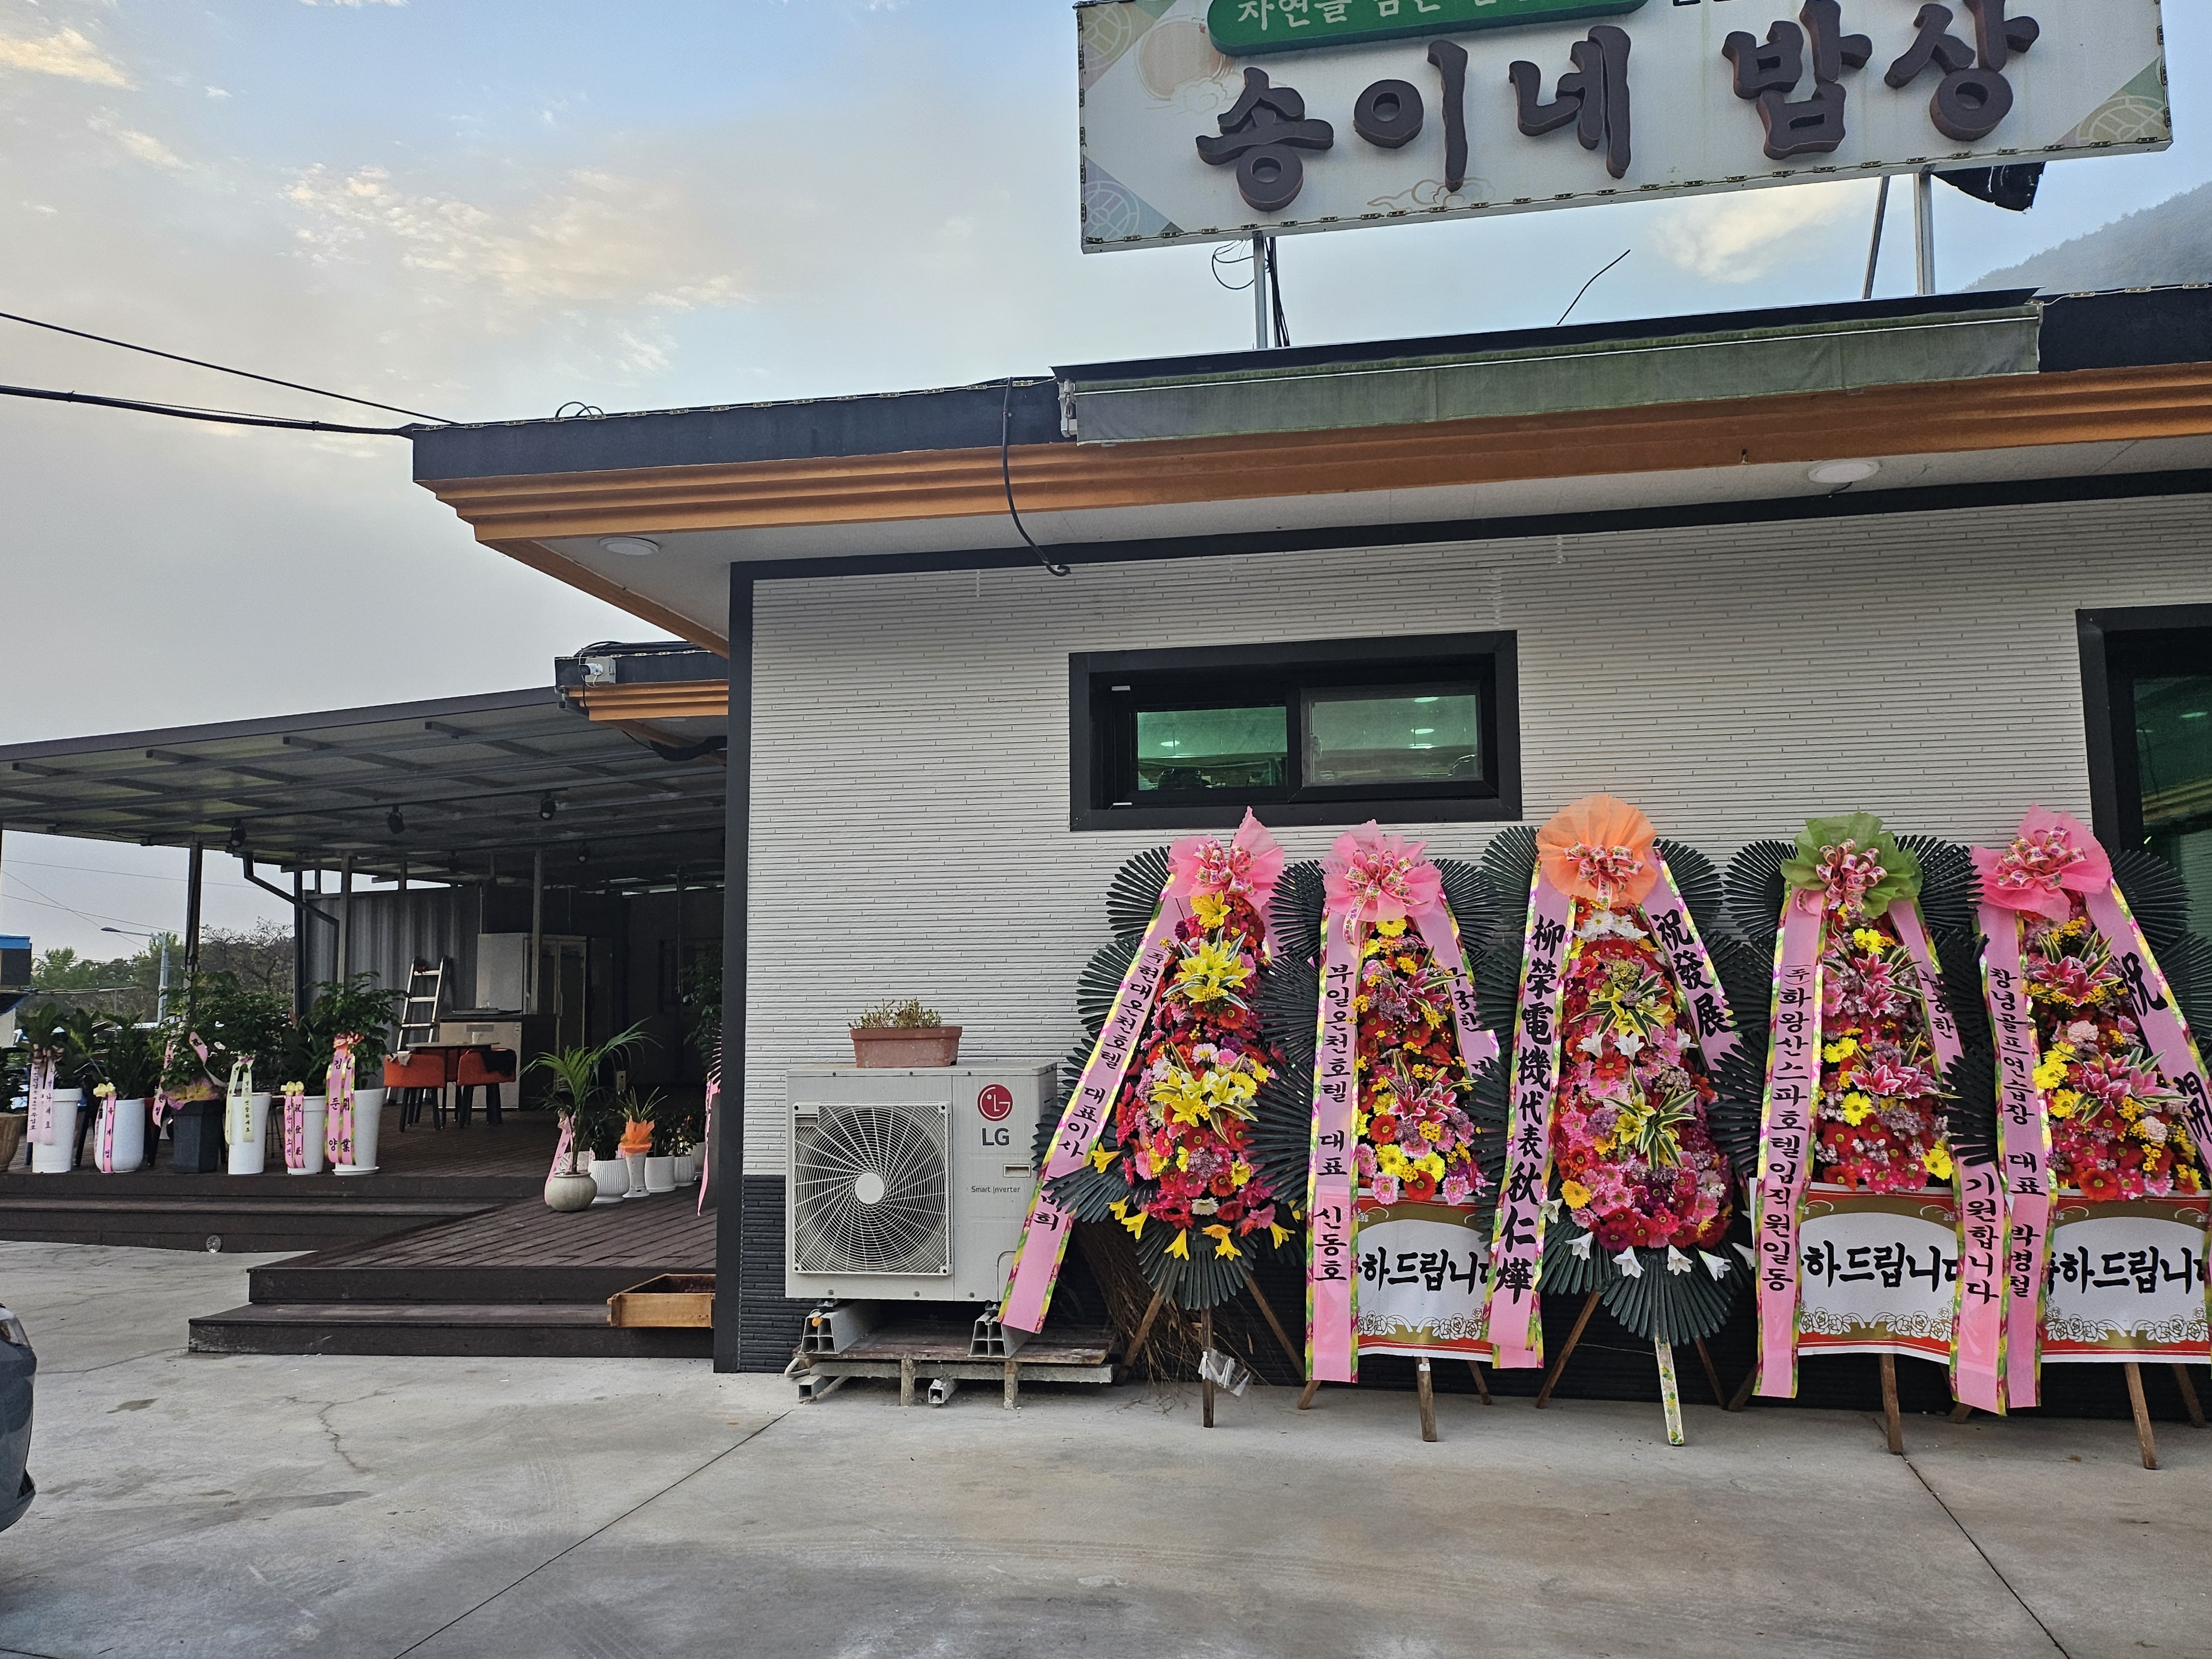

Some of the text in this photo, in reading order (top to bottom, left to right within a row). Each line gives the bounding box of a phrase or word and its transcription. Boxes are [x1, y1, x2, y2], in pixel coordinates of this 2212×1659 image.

[1196, 0, 2040, 212] 송이네 밥상
[1651, 909, 1733, 1040] 祝發展
[1990, 967, 2035, 1125] 창녕골프연습장
[982, 1128, 1010, 1146] LG
[1057, 1087, 1106, 1158] 대표이사
[1314, 963, 1353, 1282] 부일온천호텔 대표 신동호
[2008, 1152, 2047, 1196] 대표
[1358, 1246, 1490, 1294] 하드립니
[1801, 1240, 1958, 1292] 하드립니
[1966, 1172, 1999, 1305] 기원합니다
[2048, 1245, 2204, 1295] 하드립니
